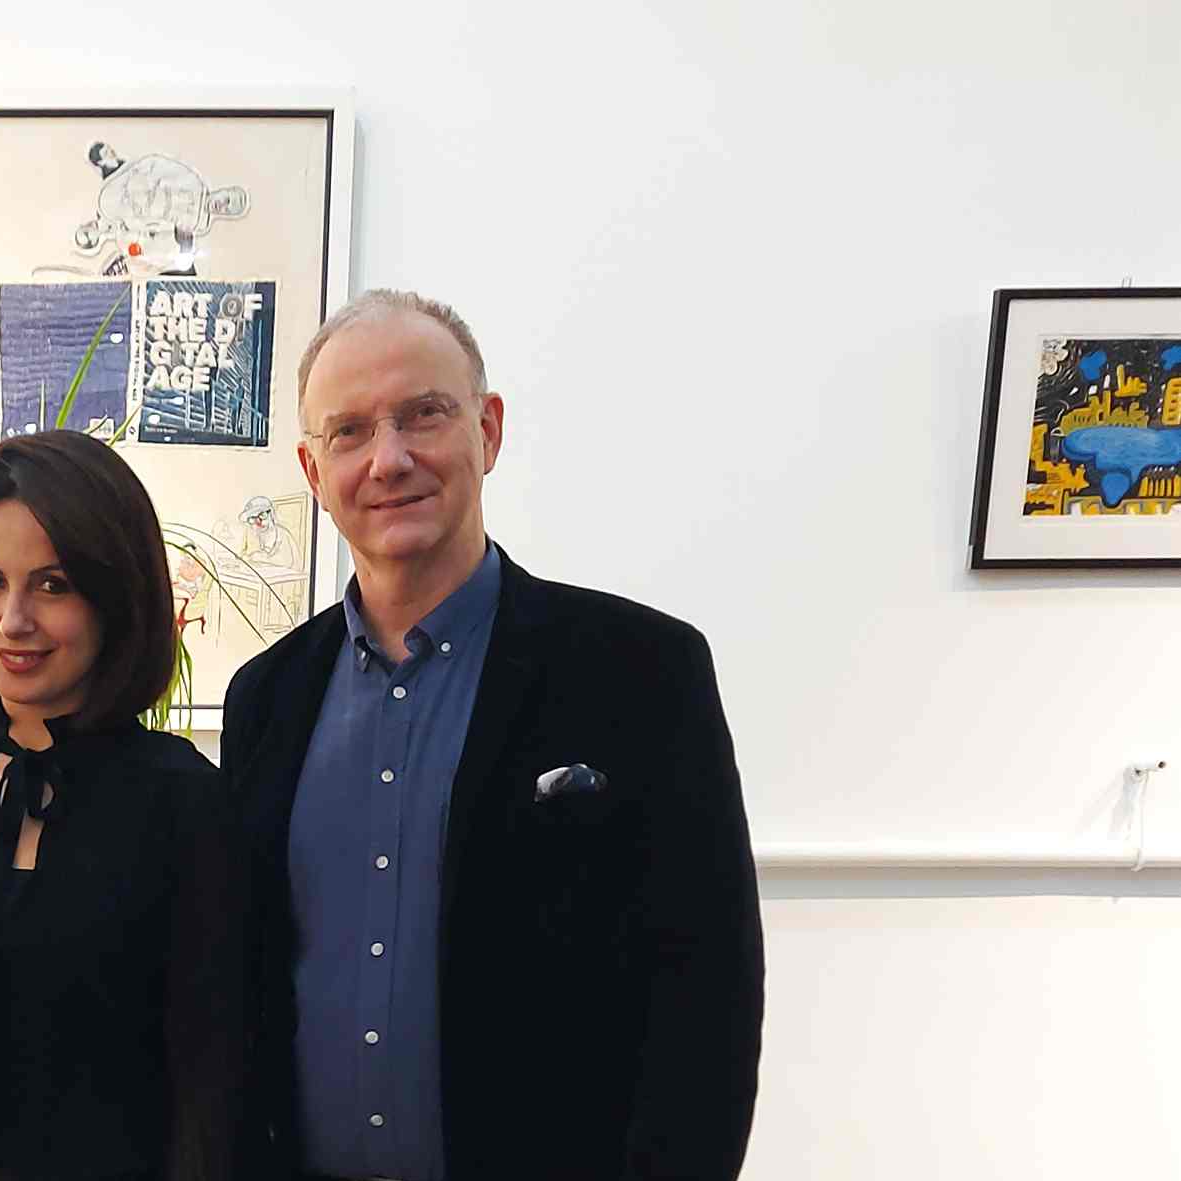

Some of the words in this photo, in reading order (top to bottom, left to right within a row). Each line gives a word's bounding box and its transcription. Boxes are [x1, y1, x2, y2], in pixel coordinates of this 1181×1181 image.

[149, 290, 212, 317] ART
[219, 293, 263, 319] OF
[148, 316, 207, 342] THE
[146, 365, 210, 391] AGE
